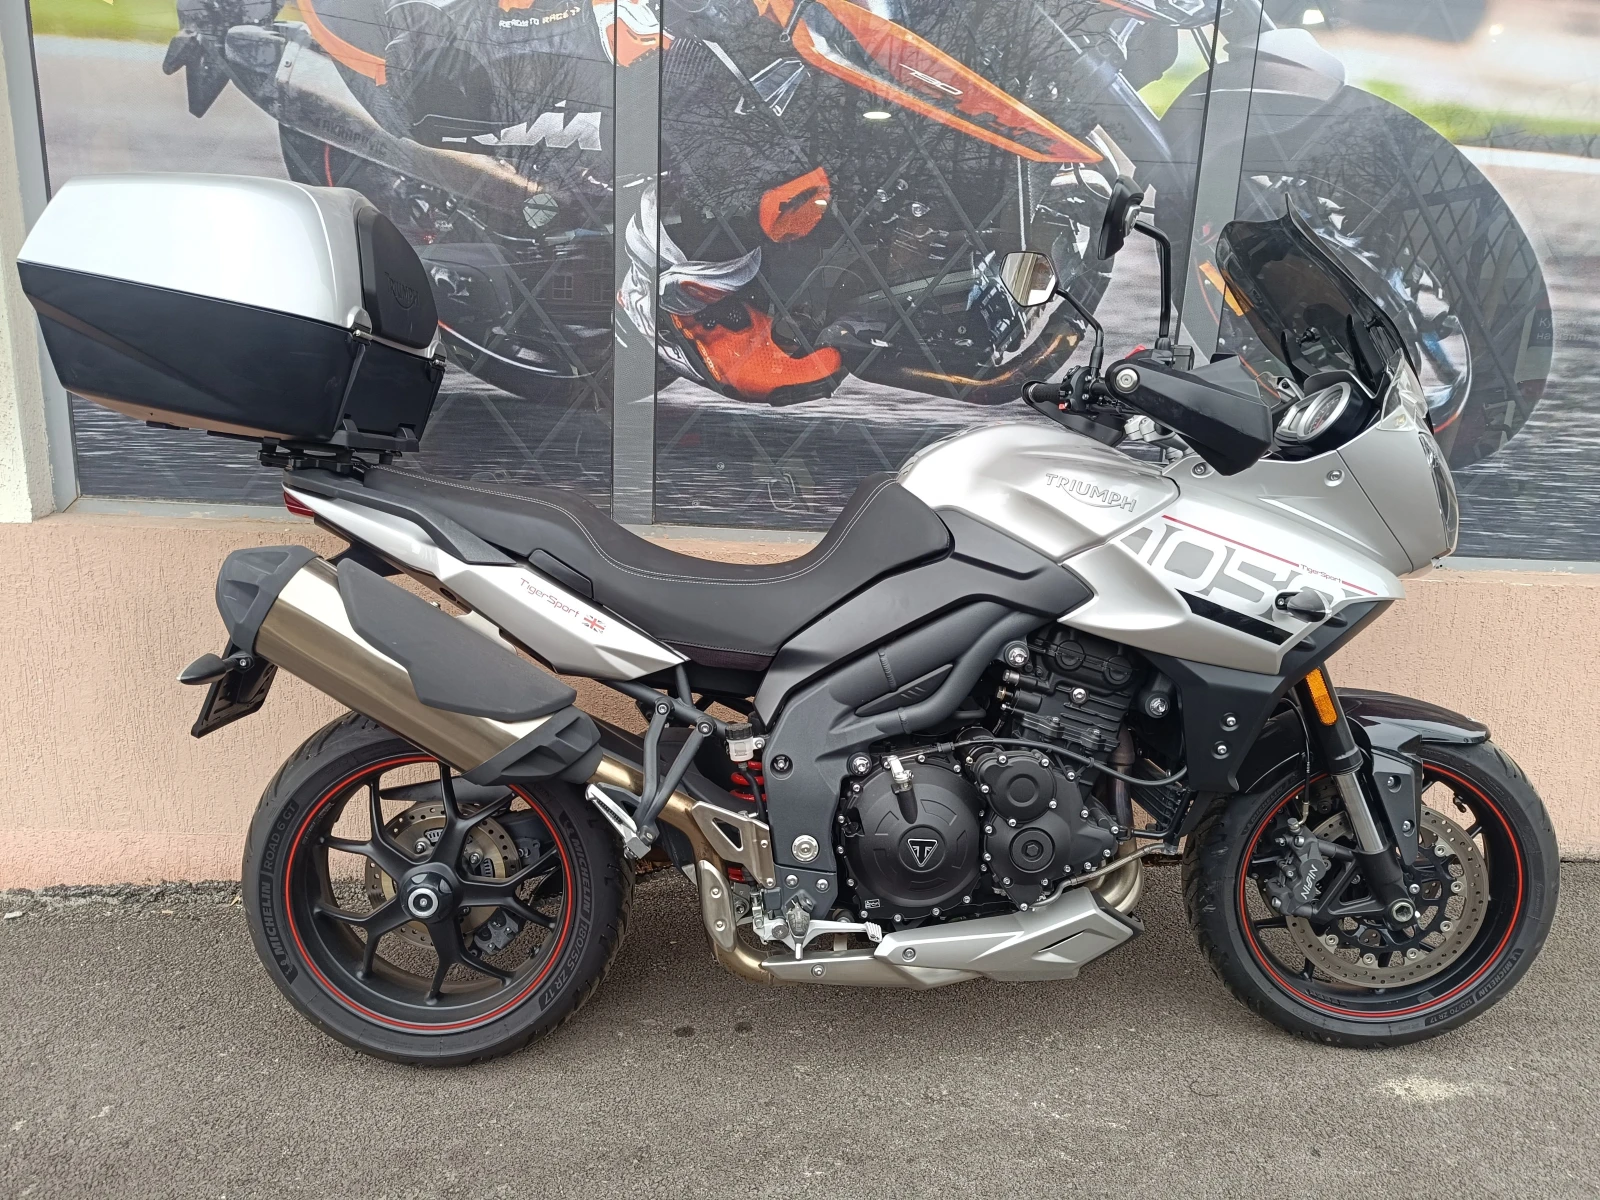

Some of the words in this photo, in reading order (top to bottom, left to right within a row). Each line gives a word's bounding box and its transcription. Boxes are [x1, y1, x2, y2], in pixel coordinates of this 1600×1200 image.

[542, 10, 569, 24] RACE
[1045, 472, 1138, 513] TRIUMPH
[1300, 563, 1342, 583] TigerSport
[520, 577, 580, 618] TigerSport
[276, 819, 287, 831] 6
[283, 802, 298, 820] GT
[264, 833, 281, 869] ROAD
[572, 838, 591, 914] MICHELIN
[262, 882, 283, 956] MICHELIN
[567, 923, 588, 972] 180/55
[553, 969, 570, 989] ZR
[1479, 962, 1513, 996] MICHELIN
[544, 987, 556, 1006] 17
